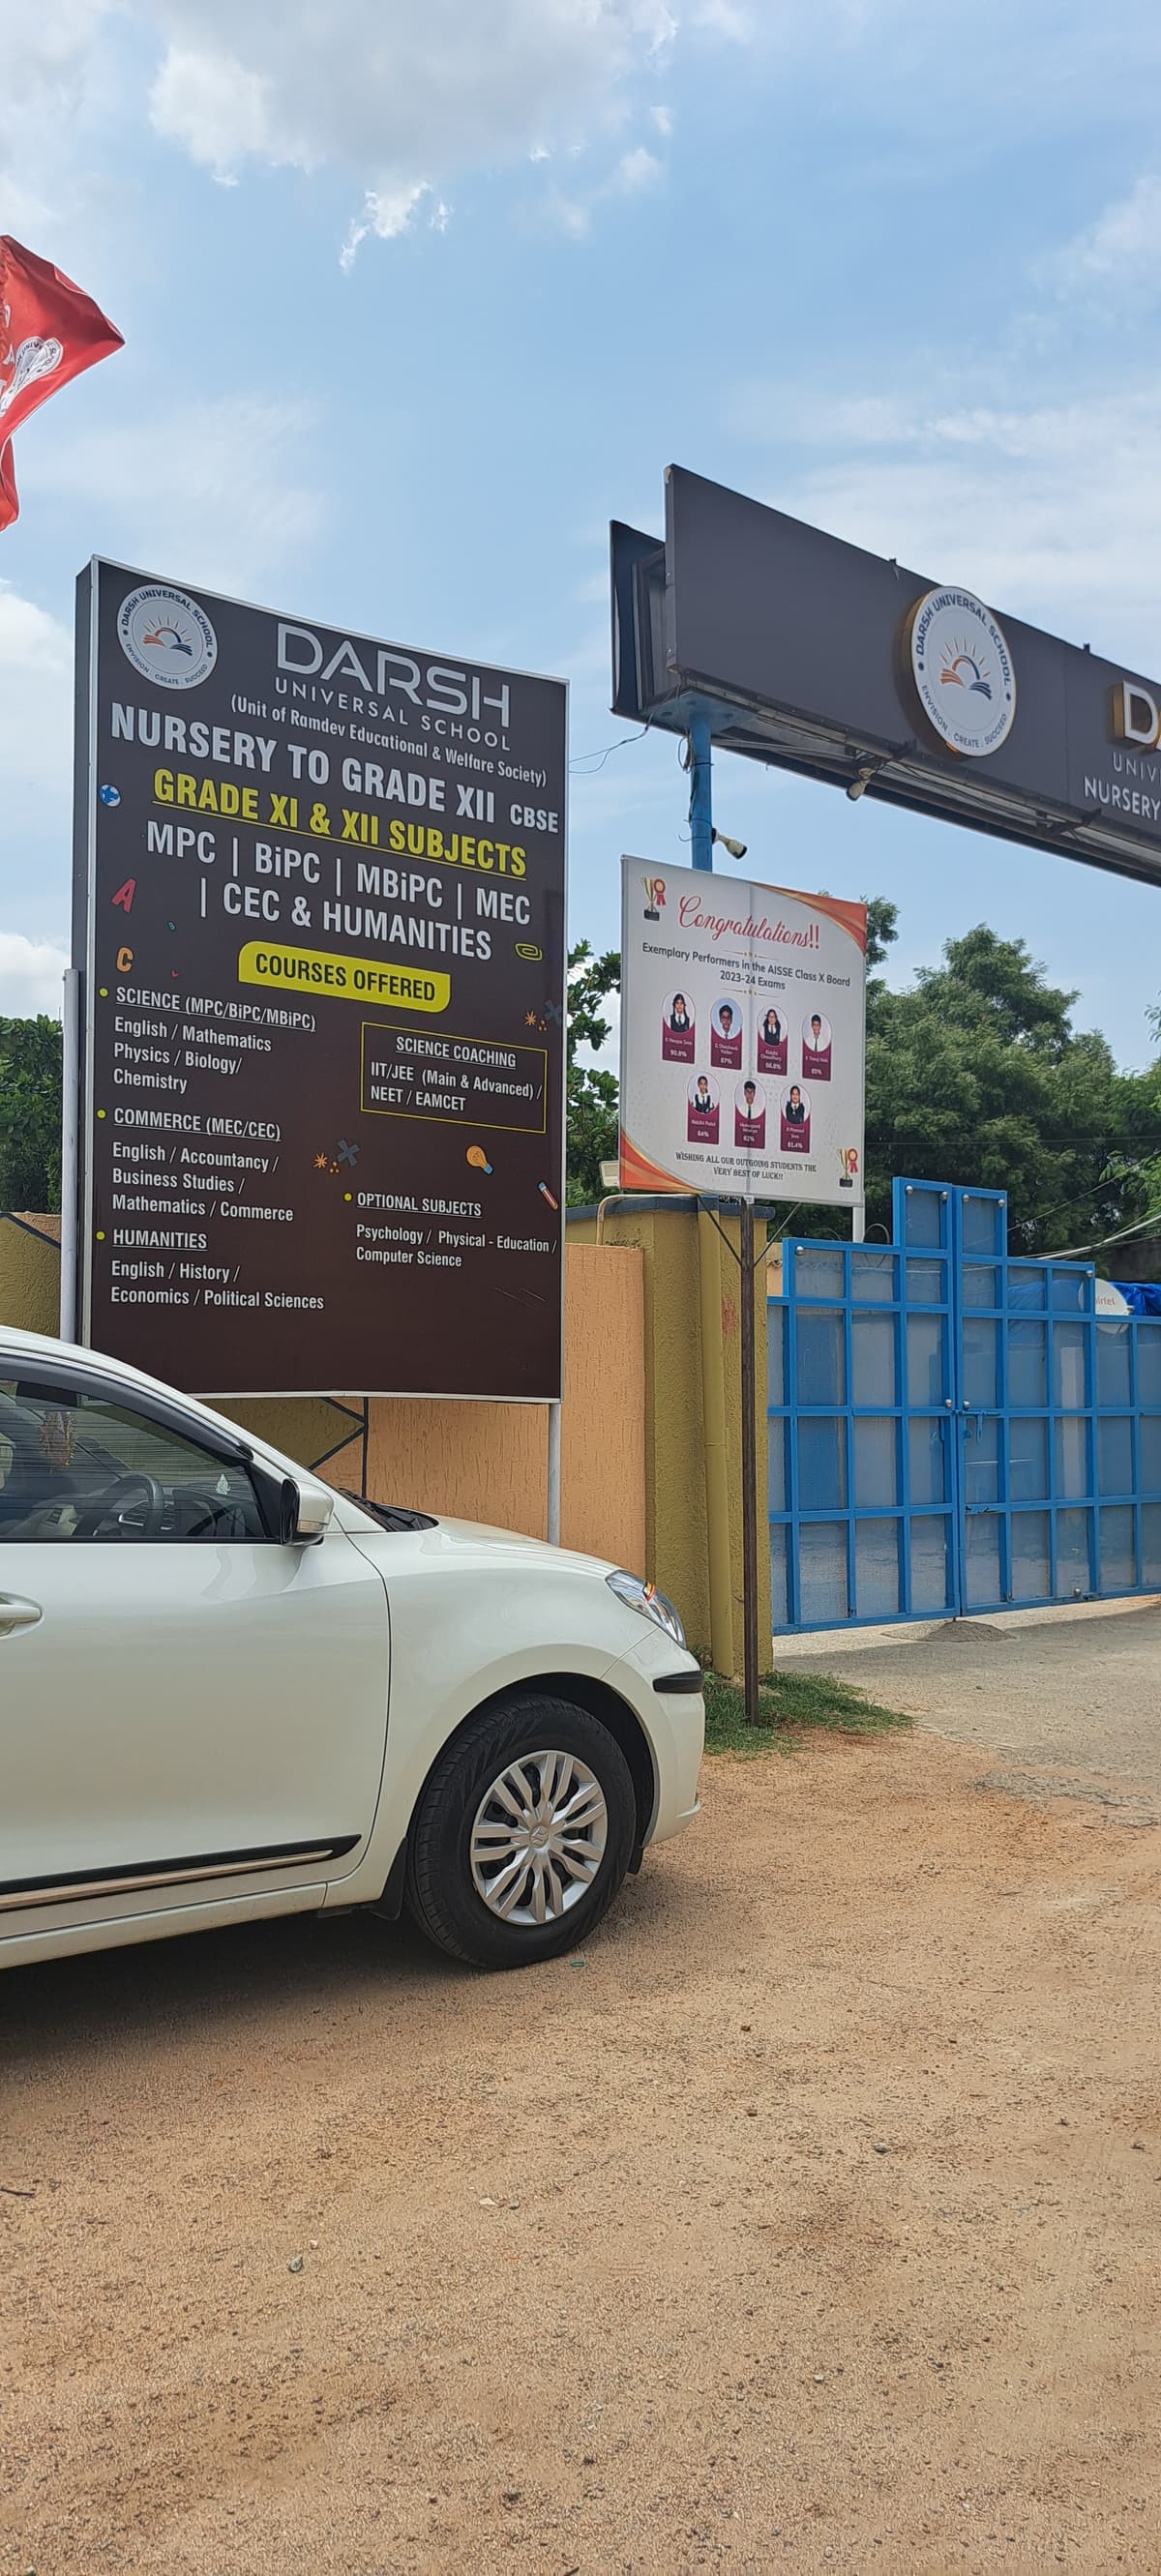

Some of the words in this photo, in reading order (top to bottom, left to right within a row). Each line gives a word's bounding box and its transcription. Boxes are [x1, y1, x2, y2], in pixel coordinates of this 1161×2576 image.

[122, 597, 138, 626] DARSH
[139, 590, 191, 610] UNIVERSAL
[193, 609, 213, 647] SCHOOL
[916, 610, 933, 656] DARSH
[933, 594, 987, 625] UNIVERSAL
[990, 625, 1009, 686] SCHOOL
[126, 643, 149, 672] ENVISION
[155, 674, 179, 685] CREATE
[185, 664, 207, 683] SUCCEED
[278, 623, 510, 727] DARSH
[275, 677, 408, 725] UNIVERSAL
[421, 715, 511, 751] SCHOOL
[921, 685, 948, 731] ENVISION
[954, 733, 980, 748] CREATE
[985, 714, 1007, 745] SUCCEED
[1117, 680, 1161, 751] D
[231, 695, 267, 720] (Unit
[272, 706, 286, 723] of
[291, 710, 345, 736] Ramdev
[350, 725, 428, 758] Educational
[432, 746, 441, 761] &
[445, 748, 493, 773] Welfare
[498, 761, 547, 787] Society)
[112, 703, 277, 773] NURSERY
[287, 745, 329, 785] TO
[342, 758, 445, 812] GRADE
[457, 787, 493, 823] XII
[510, 804, 558, 834] CBSE
[1084, 777, 1161, 821] NURSERY
[155, 769, 258, 819] GRADE
[270, 794, 297, 828] XI
[311, 805, 331, 833] &
[342, 810, 378, 845] XII
[390, 819, 526, 875] SUBJECTS
[147, 822, 216, 863] MPC
[255, 843, 320, 884] BiPC
[357, 864, 443, 908] MBiPC
[476, 888, 530, 925] MEC
[111, 877, 136, 913] A
[223, 882, 280, 921] CEC
[291, 897, 311, 927] &
[324, 902, 491, 960] HUMANITIES
[679, 896, 819, 949] Congratulations!!
[117, 947, 134, 972] C
[255, 953, 346, 987] COURSES
[354, 970, 435, 1001] OFFERED
[642, 942, 690, 962] Exemplary
[693, 951, 738, 969] Performers
[742, 959, 749, 969] in
[752, 962, 765, 973] the
[768, 962, 792, 978] AISSE
[795, 969, 817, 982] Class
[819, 972, 824, 983] X
[827, 974, 850, 987] Board
[720, 969, 756, 986] 2023-24
[759, 977, 786, 990] Exams
[116, 987, 180, 1011] SCIENCE
[186, 996, 316, 1031] (MPC/BiPC/MBiPC)
[115, 1017, 167, 1041] English
[183, 1026, 271, 1051] Mathematics
[114, 1043, 170, 1067] Physics
[185, 1051, 242, 1075] Biology/
[396, 1037, 449, 1059] SCIENCE
[454, 1045, 516, 1068] COACHING
[114, 1069, 187, 1094] Chemistry
[371, 1062, 414, 1081] IIT/JEE
[422, 1068, 457, 1089] (Main
[461, 1075, 469, 1089] &
[473, 1076, 534, 1100] Advanced)
[371, 1086, 402, 1104] NEET
[415, 1091, 465, 1110] EAMCET
[114, 1109, 200, 1133] COMMERCE
[206, 1117, 281, 1140] (MEC/CEC)
[113, 1143, 165, 1164] English
[180, 1150, 269, 1173] Accountancy
[674, 1151, 704, 1162] WISHING
[706, 1154, 719, 1163] ALL
[736, 1158, 768, 1168] OUTGOING
[770, 1162, 802, 1170] STUDENTS
[761, 1170, 783, 1180] LUCK!!
[112, 1169, 177, 1189] Business
[183, 1173, 234, 1193] Studies
[112, 1195, 205, 1215] Mathematics
[221, 1201, 293, 1222] Commerce
[357, 1192, 418, 1212] OPTIONAL
[422, 1199, 481, 1216] SUBJECTS
[114, 1229, 207, 1249] HUMANITIES
[357, 1225, 423, 1246] Psychology
[438, 1231, 485, 1247] Physical
[497, 1236, 549, 1253] Education
[112, 1262, 164, 1281] English
[180, 1264, 229, 1283] History
[356, 1247, 413, 1266] Computer
[417, 1251, 461, 1267] Science
[110, 1288, 189, 1305] Economics
[204, 1290, 259, 1308] Political
[264, 1293, 324, 1309] Sciences
